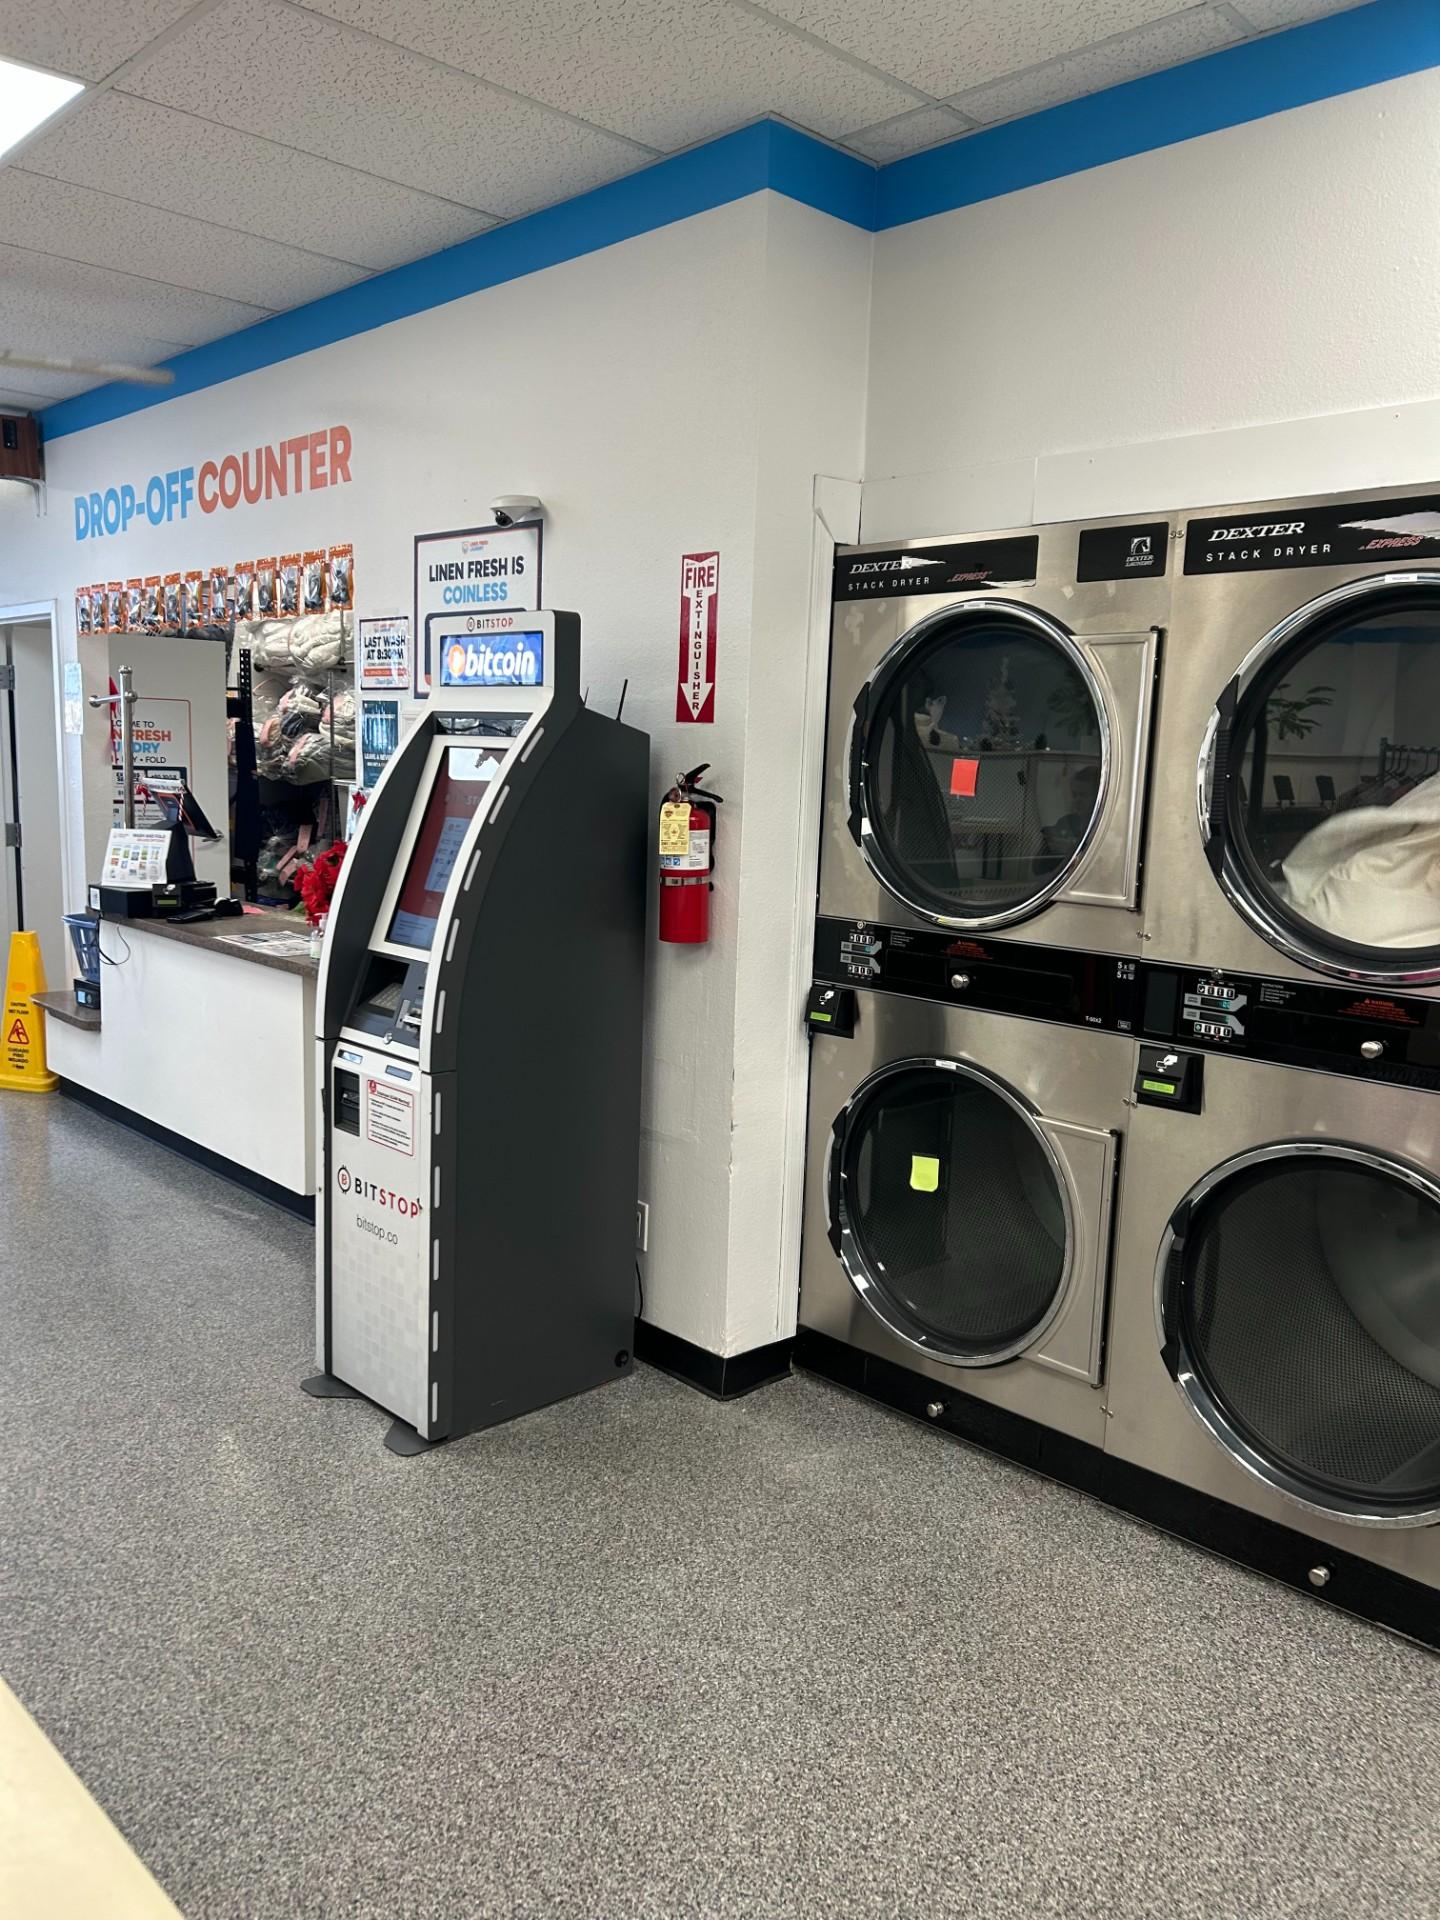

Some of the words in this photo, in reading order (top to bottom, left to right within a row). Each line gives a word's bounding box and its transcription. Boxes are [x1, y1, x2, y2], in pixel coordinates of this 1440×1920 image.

[75, 467, 194, 541] DROP-OFF
[199, 425, 352, 513] COUNTER
[1207, 522, 1305, 542] DEXTER
[1206, 549, 1261, 562] STACK
[1274, 543, 1331, 558] DRYER
[429, 562, 464, 582] LINEN
[468, 558, 508, 578] FRESH
[512, 556, 524, 575] IS
[685, 565, 715, 589] FIRE
[849, 560, 912, 574] DEXTER
[443, 582, 508, 605] COINLESS
[848, 581, 884, 591] STACK
[892, 577, 930, 587] DRYER
[476, 617, 513, 629] BITSTOP
[364, 636, 381, 648] LAST
[692, 589, 703, 710] EXTINGUISHER
[367, 649, 375, 660] AT
[464, 642, 535, 677] bitcoin
[355, 1177, 419, 1218] BITSTOP
[356, 1214, 399, 1246] bitstop.co
